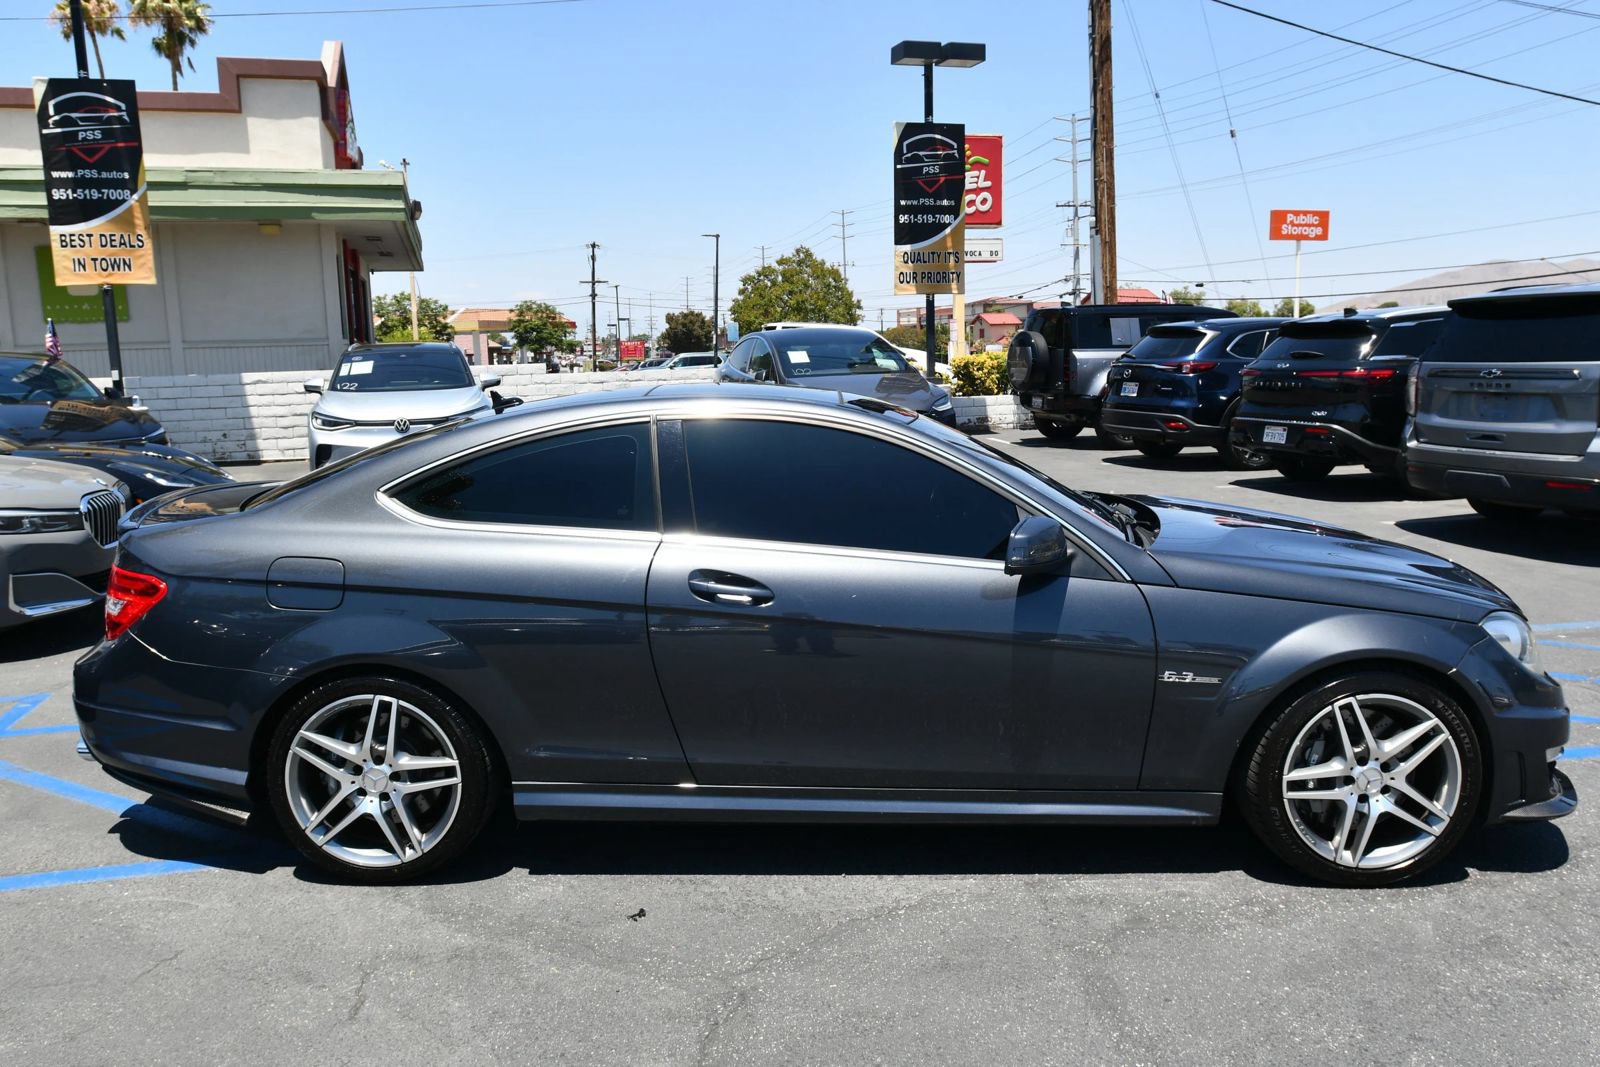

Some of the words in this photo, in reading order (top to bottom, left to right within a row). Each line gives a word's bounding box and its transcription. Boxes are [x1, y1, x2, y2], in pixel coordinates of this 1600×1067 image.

[78, 130, 102, 141] PSS
[50, 169, 130, 179] www.PSS.autos
[922, 165, 940, 174] PSS
[965, 169, 992, 190] EL
[51, 188, 131, 200] 951-519-7008
[899, 198, 955, 206] www.PSS.autos
[965, 191, 993, 214] CO
[898, 214, 955, 224] 951-519-7008
[1286, 213, 1320, 225] Public
[1281, 224, 1323, 238] Storage
[59, 233, 94, 249] BEST
[99, 233, 145, 249] DEALS
[902, 251, 942, 265] QUALITY
[944, 251, 960, 264] IT'S
[72, 257, 87, 273] IN
[91, 257, 132, 273] TOWN
[898, 271, 918, 285] OUR
[920, 271, 961, 284] PRIORITY
[1163, 670, 1194, 683] 6.3
